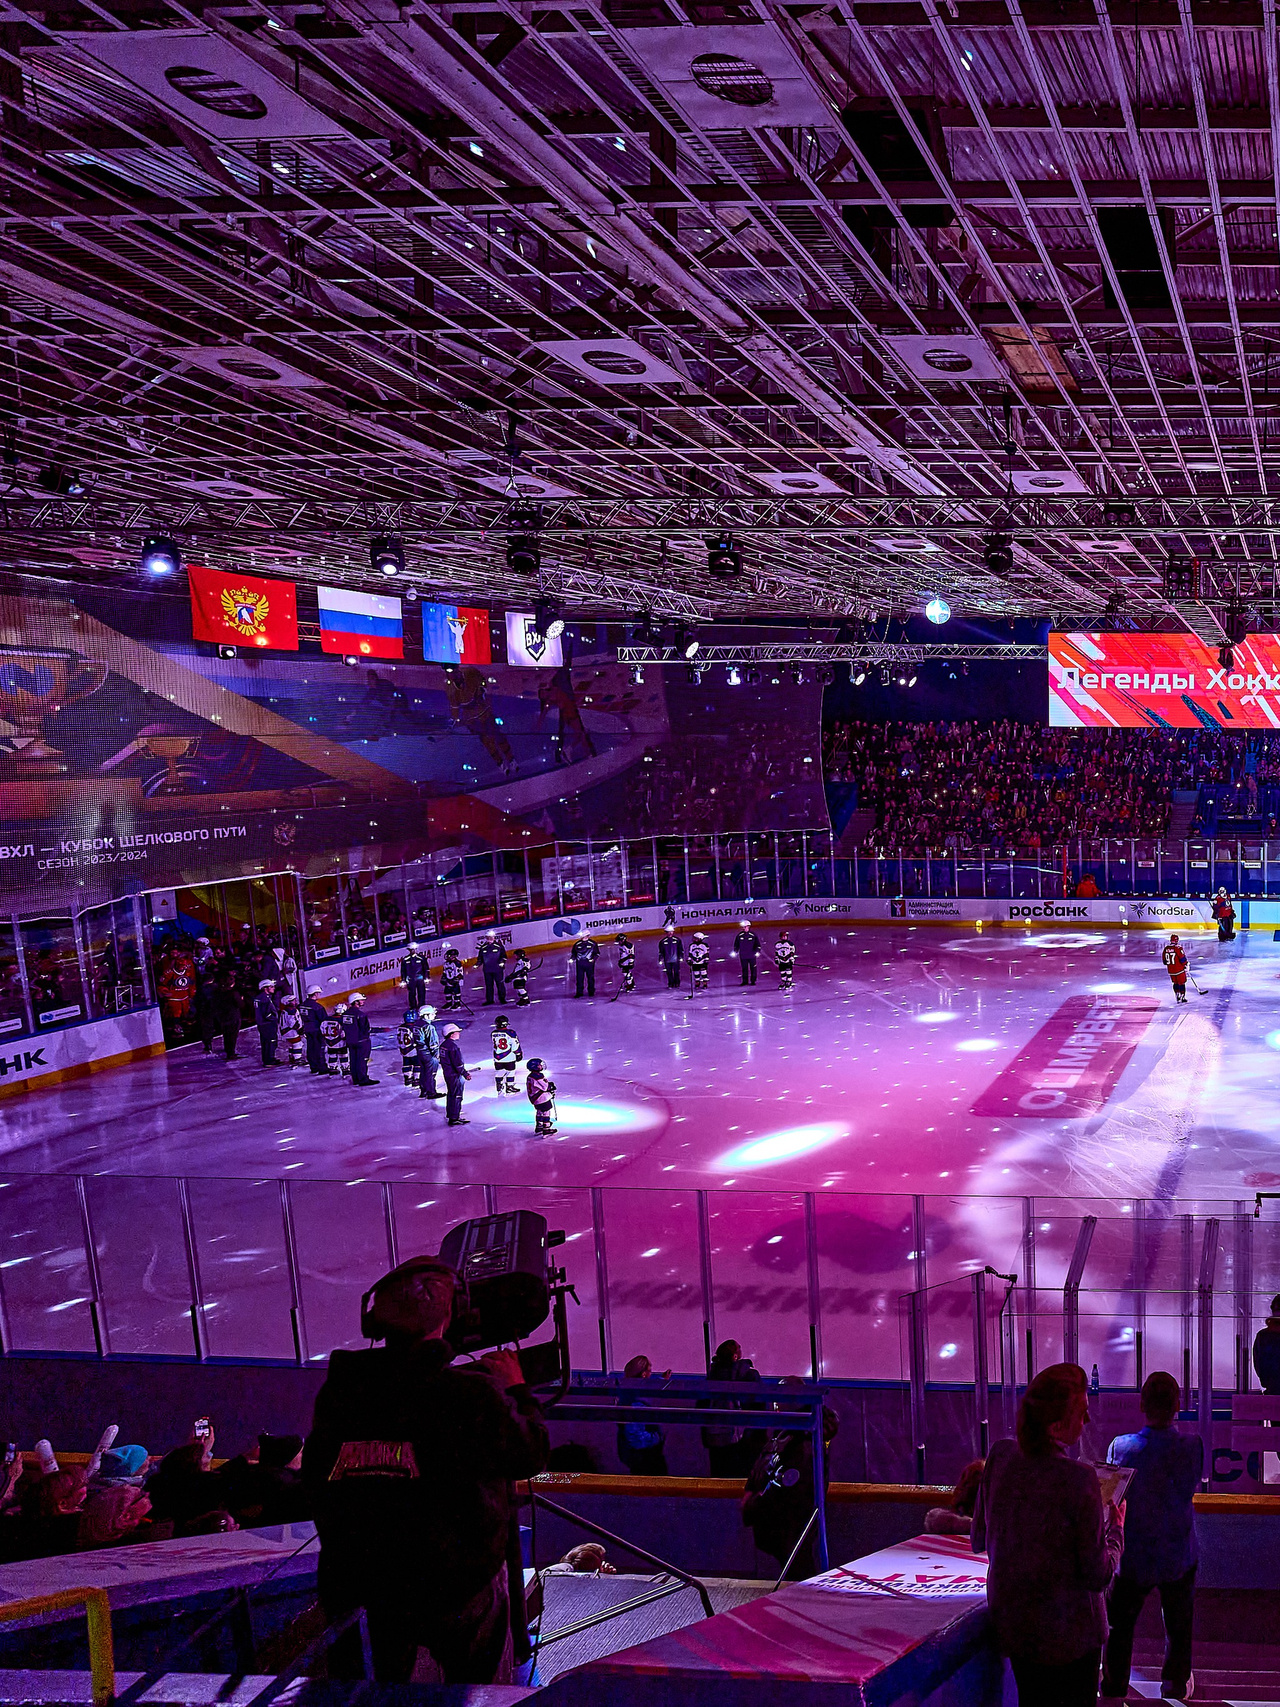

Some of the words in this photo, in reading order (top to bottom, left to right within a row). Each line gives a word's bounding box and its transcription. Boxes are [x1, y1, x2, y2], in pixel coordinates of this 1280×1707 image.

[1057, 667, 1195, 694] Легенды
[0, 844, 35, 859] ВХЛ
[61, 837, 114, 854] КУБОК
[120, 829, 209, 848] ШЕЛКОВОГО
[214, 825, 247, 839] ПУТИ
[38, 857, 79, 870] СЕЗОН
[83, 850, 148, 866] 2023/2024
[681, 907, 733, 920] НОЧНАЯ
[734, 906, 767, 917] ЛИГА
[804, 903, 852, 914] NordStar
[1009, 901, 1089, 919] росбанк
[1147, 906, 1195, 916] NordStar
[586, 915, 643, 929] НОРНИКЕЛЬ
[1165, 952, 1176, 965] 97
[350, 958, 396, 980] КРАСНАЯ
[1018, 996, 1130, 1110] OLIMPBET
